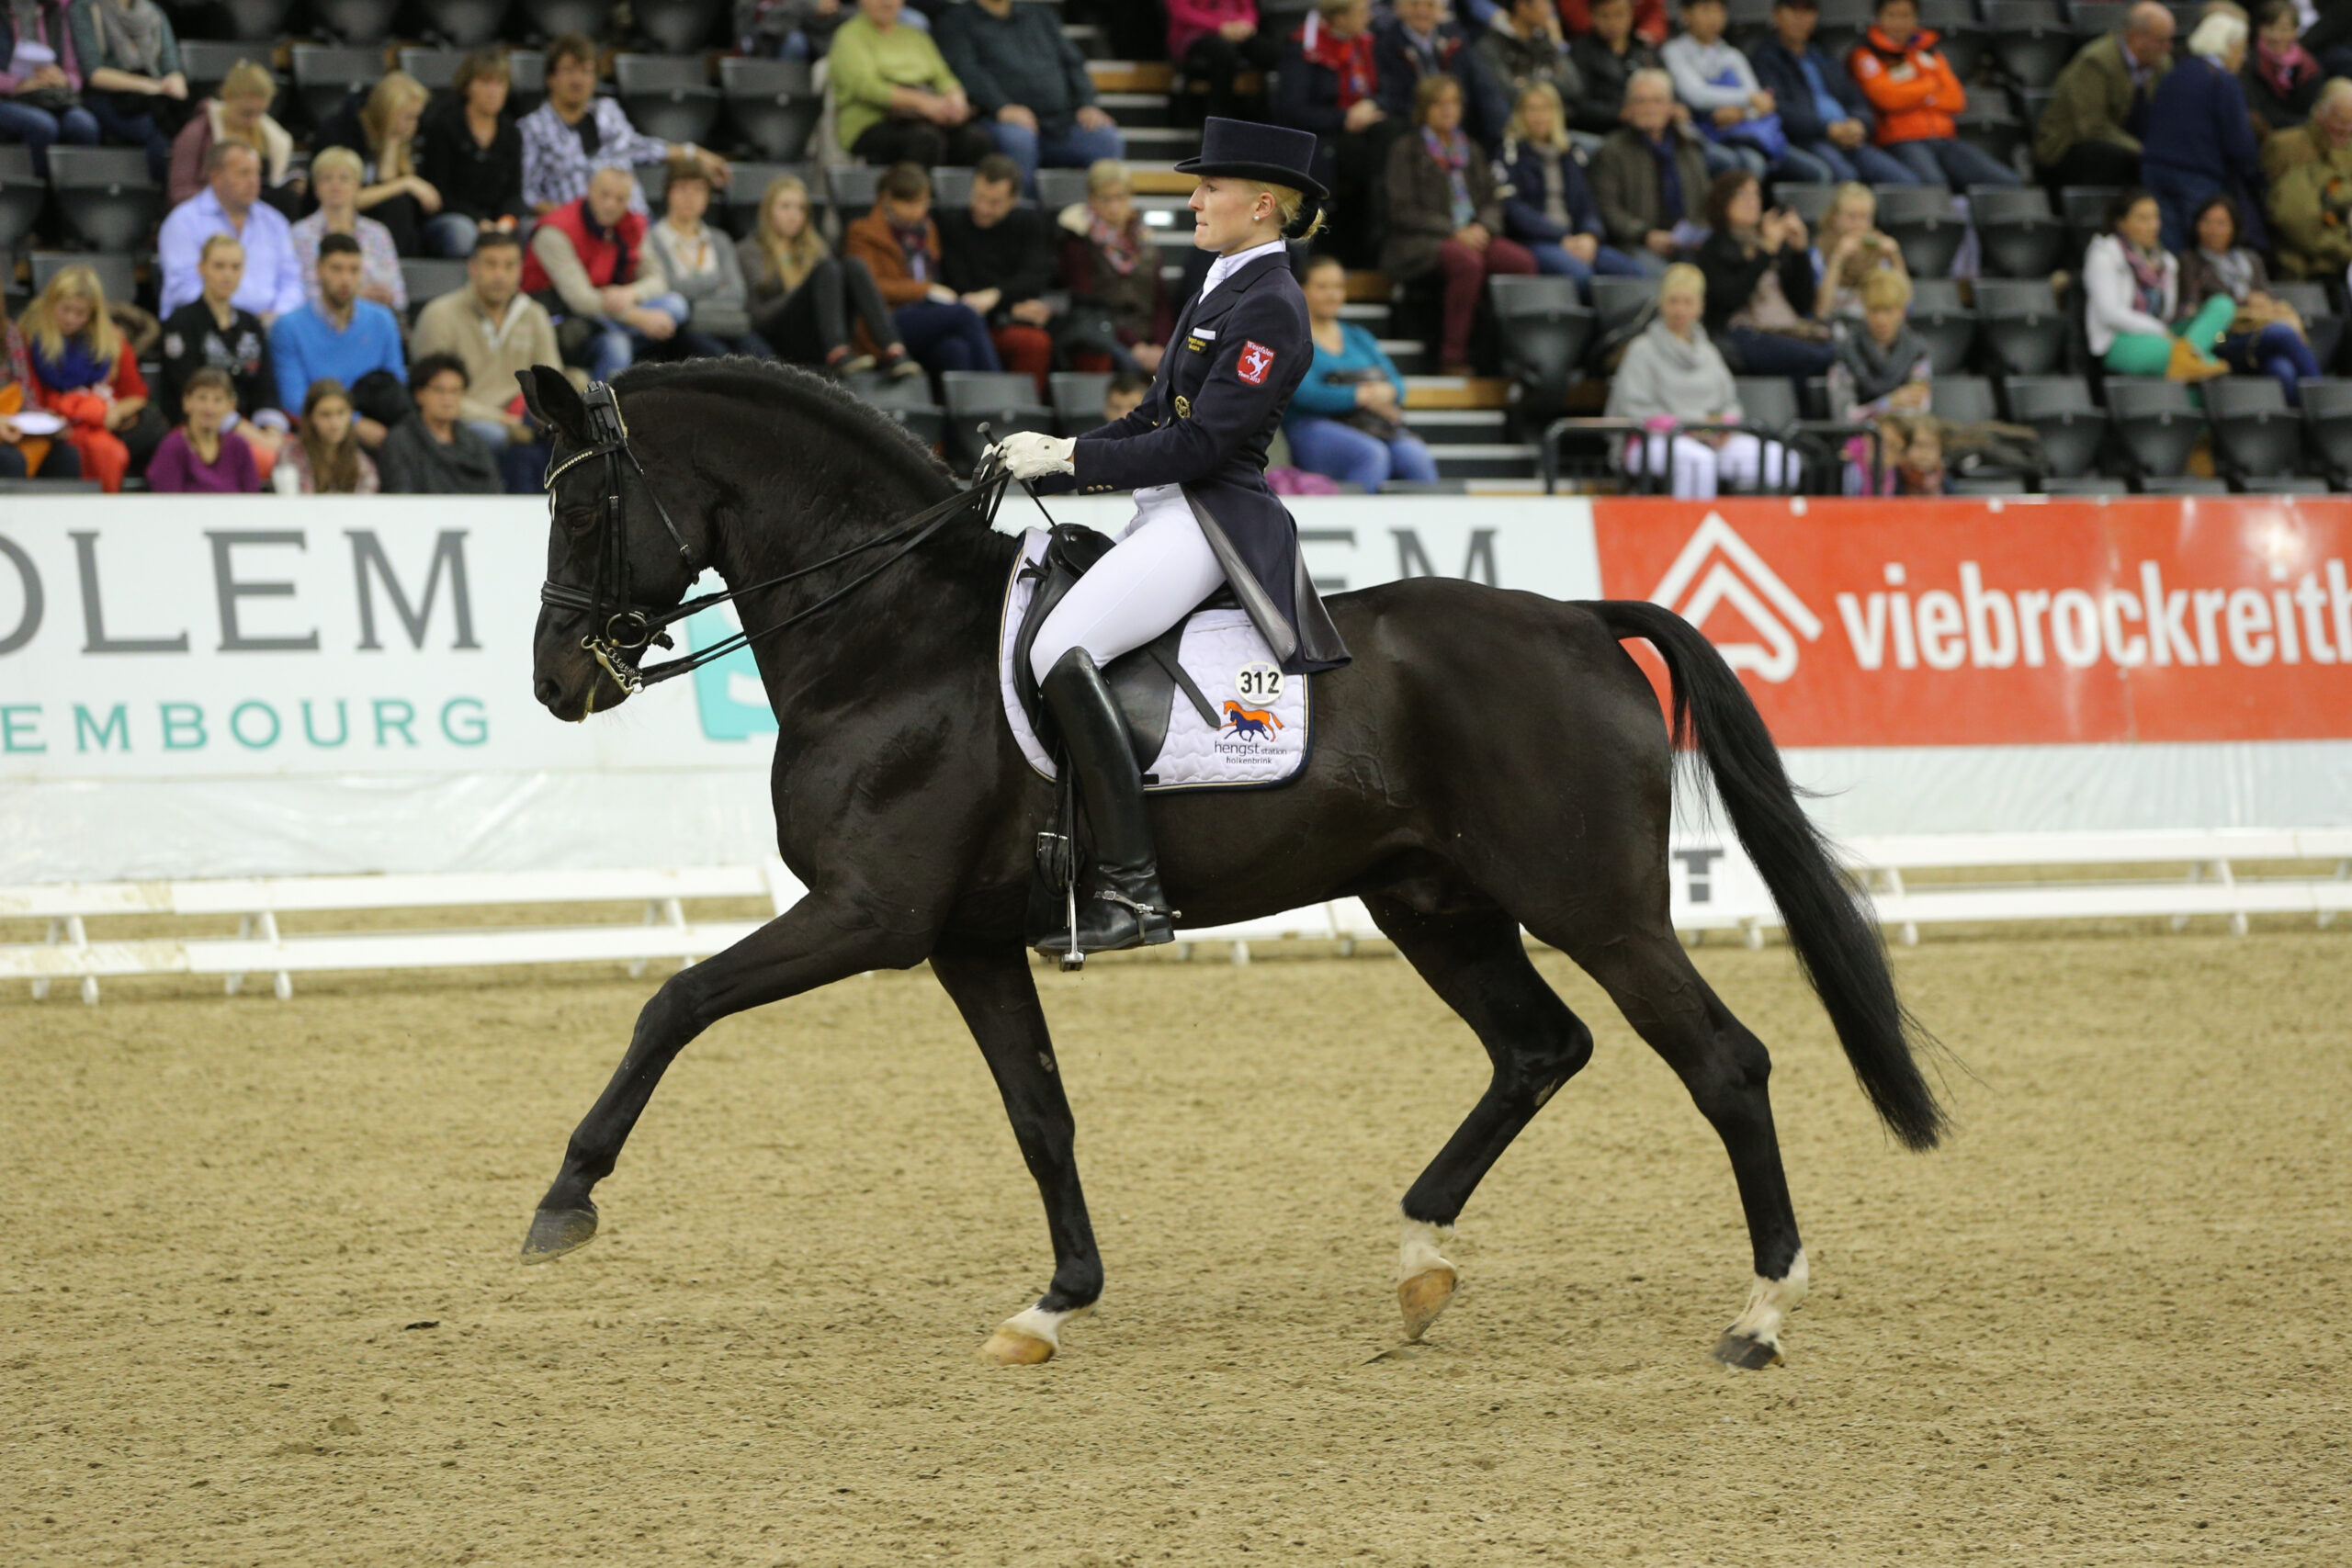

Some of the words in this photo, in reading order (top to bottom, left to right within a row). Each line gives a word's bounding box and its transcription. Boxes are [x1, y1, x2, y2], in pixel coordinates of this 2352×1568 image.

[1247, 340, 1274, 358] Westfalen
[1240, 671, 1280, 694] 312
[1215, 740, 1260, 756] hengst
